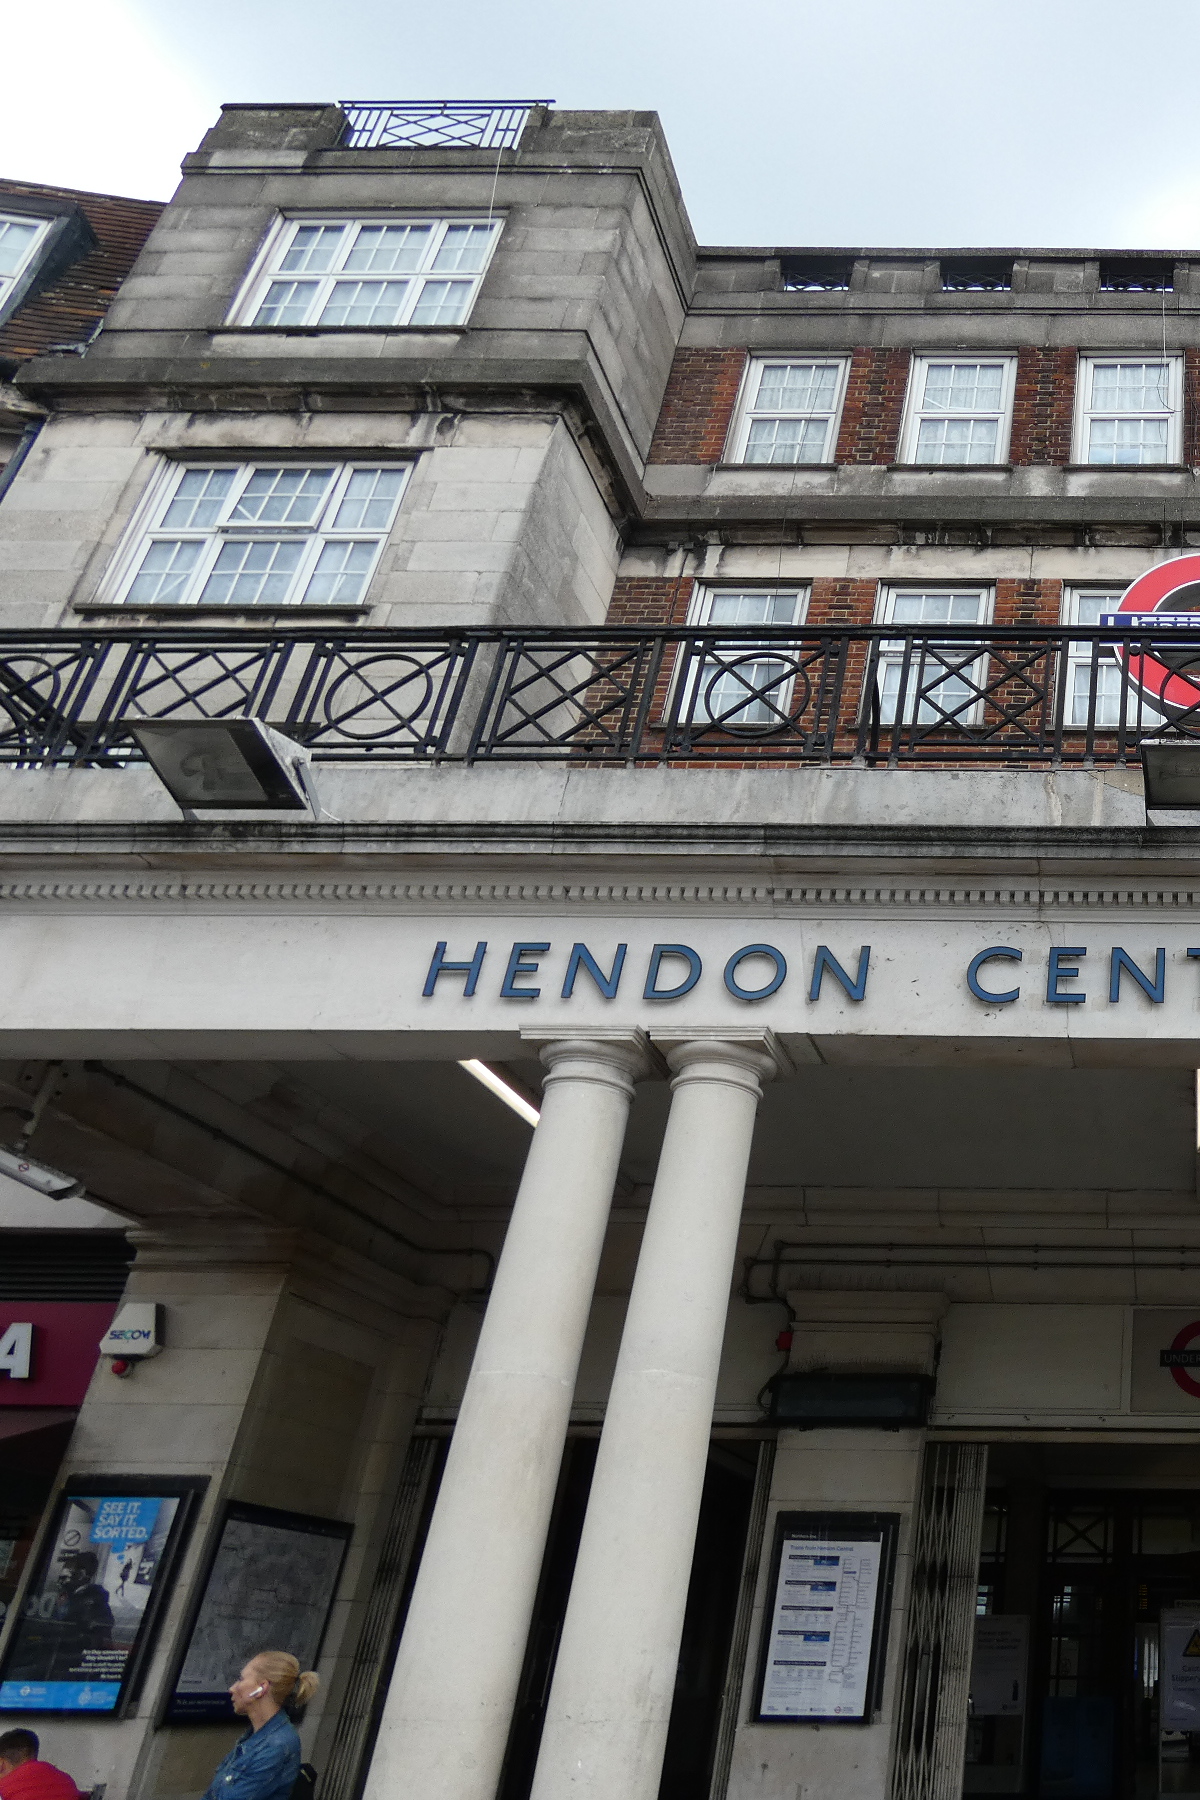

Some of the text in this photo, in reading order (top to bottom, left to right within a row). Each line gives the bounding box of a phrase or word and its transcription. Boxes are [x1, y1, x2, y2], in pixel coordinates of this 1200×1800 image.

[422, 941, 871, 1001] HENDON
[109, 1329, 151, 1340] SECOM
[101, 1502, 141, 1514] SEE IT.
[98, 1514, 137, 1526] SAY IT.
[93, 1526, 148, 1539] SORTED.
